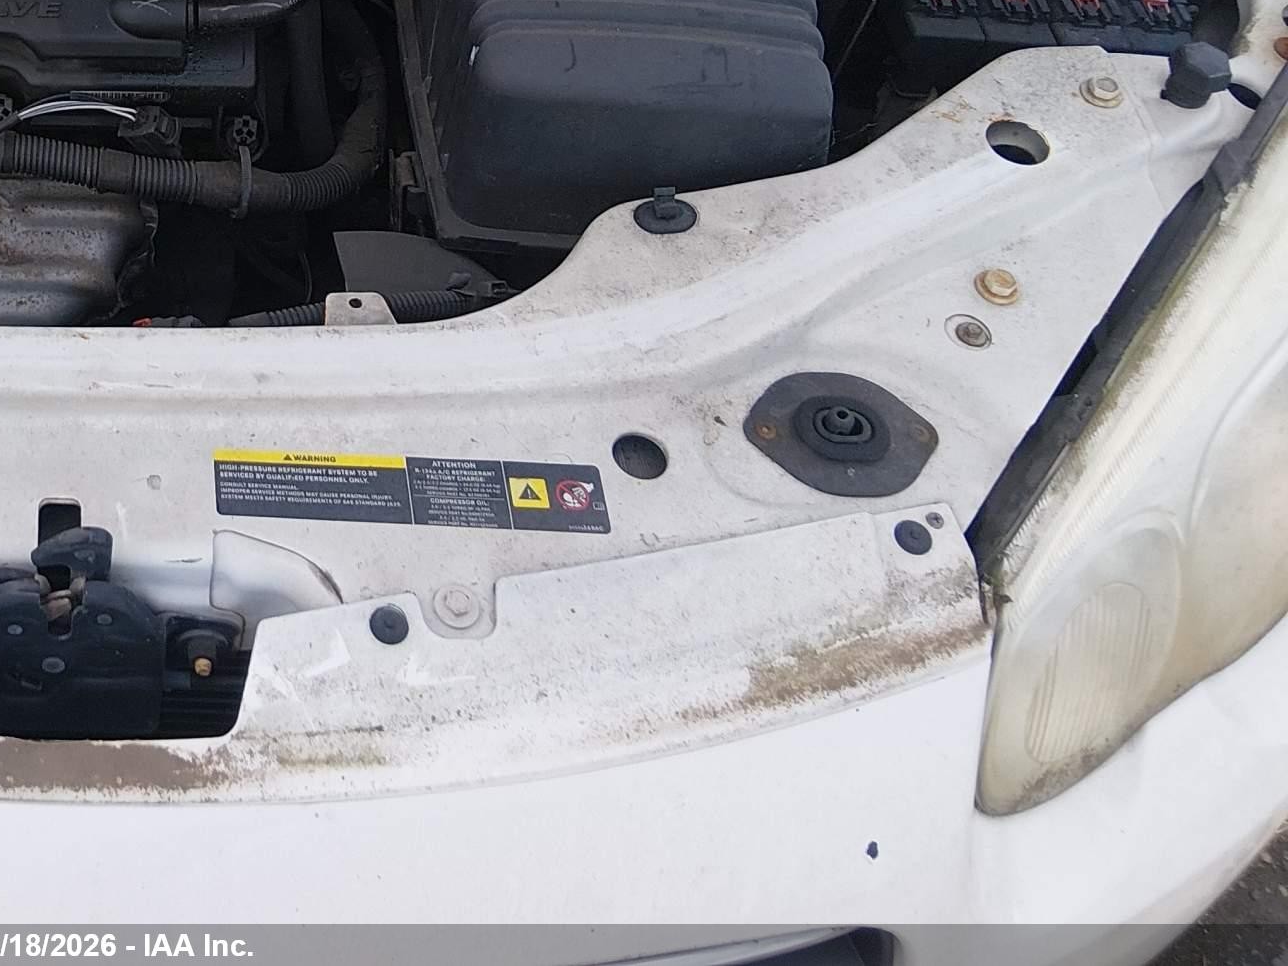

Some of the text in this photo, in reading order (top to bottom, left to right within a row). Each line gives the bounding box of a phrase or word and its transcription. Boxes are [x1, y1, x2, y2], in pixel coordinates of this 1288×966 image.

[293, 454, 337, 464] WARNING
[219, 464, 277, 473] HIGH-PRESSURE
[278, 467, 326, 475] REFRIGERANT
[432, 461, 476, 469] ATTENTION
